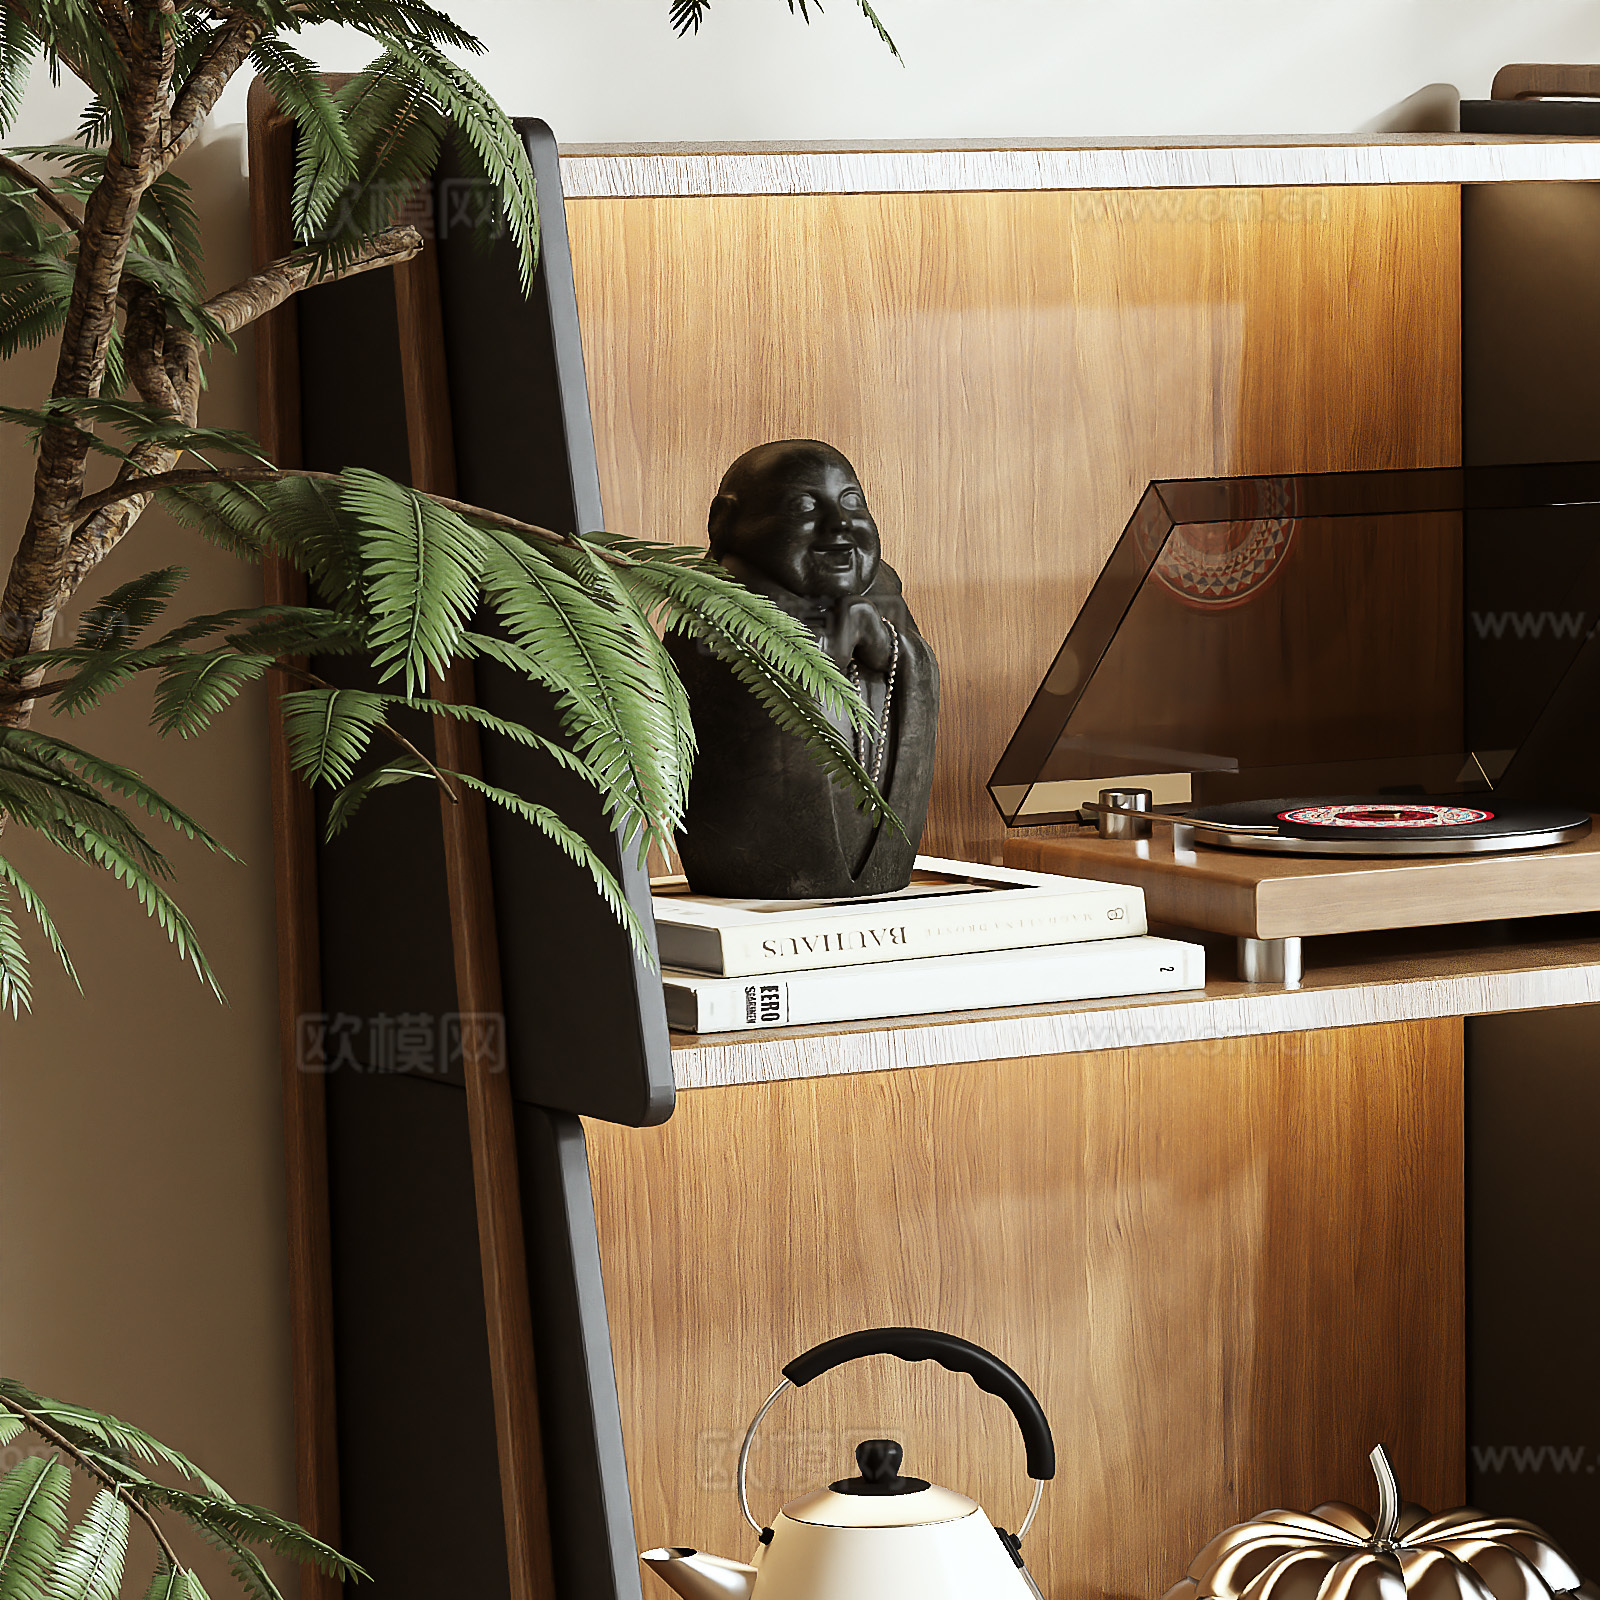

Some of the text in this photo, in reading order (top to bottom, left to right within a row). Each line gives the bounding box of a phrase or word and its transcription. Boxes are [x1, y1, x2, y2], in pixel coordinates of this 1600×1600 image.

[762, 928, 907, 959] BAUHAUS
[1159, 965, 1175, 975] 2
[760, 985, 780, 1022] EERO
